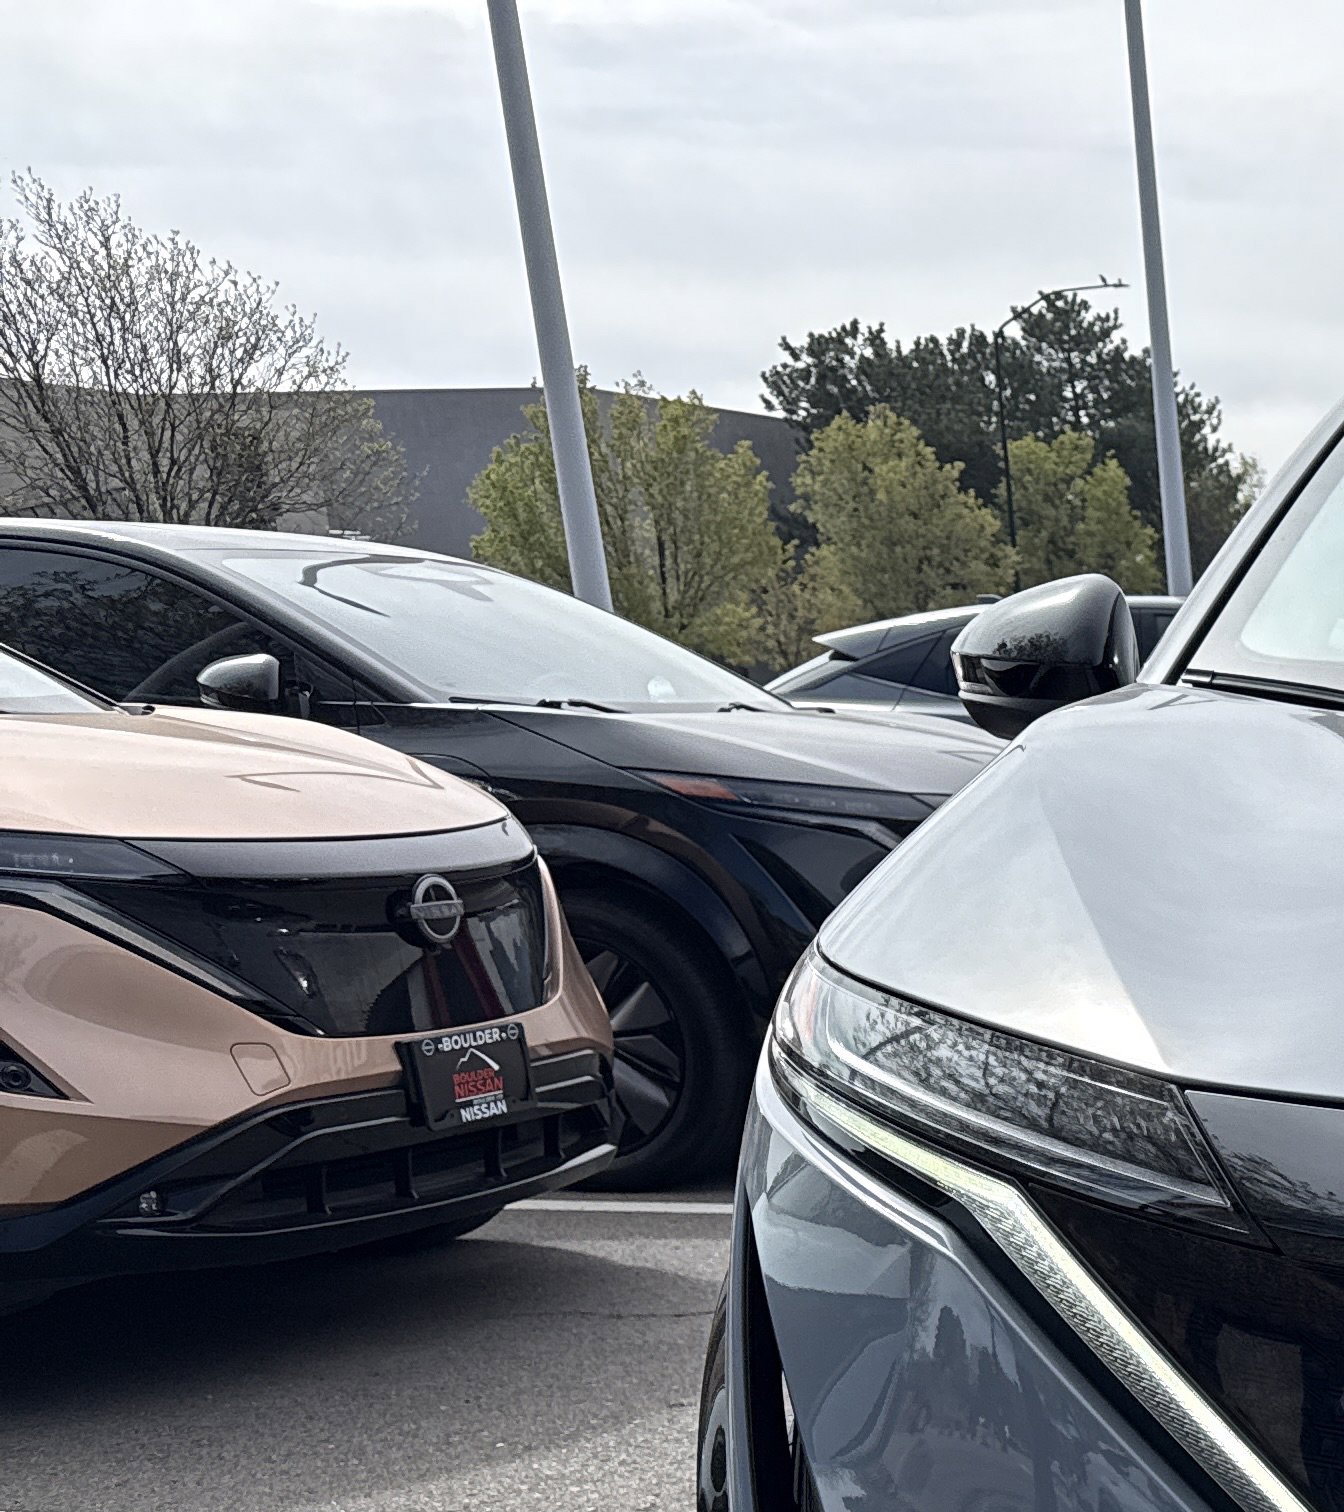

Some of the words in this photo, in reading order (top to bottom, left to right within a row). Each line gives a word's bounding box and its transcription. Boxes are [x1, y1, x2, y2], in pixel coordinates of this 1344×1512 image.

[442, 1028, 501, 1051] BOULDER
[453, 1068, 495, 1083] BOULDER
[454, 1077, 503, 1098] NISSAN
[460, 1101, 508, 1122] NISSAN
